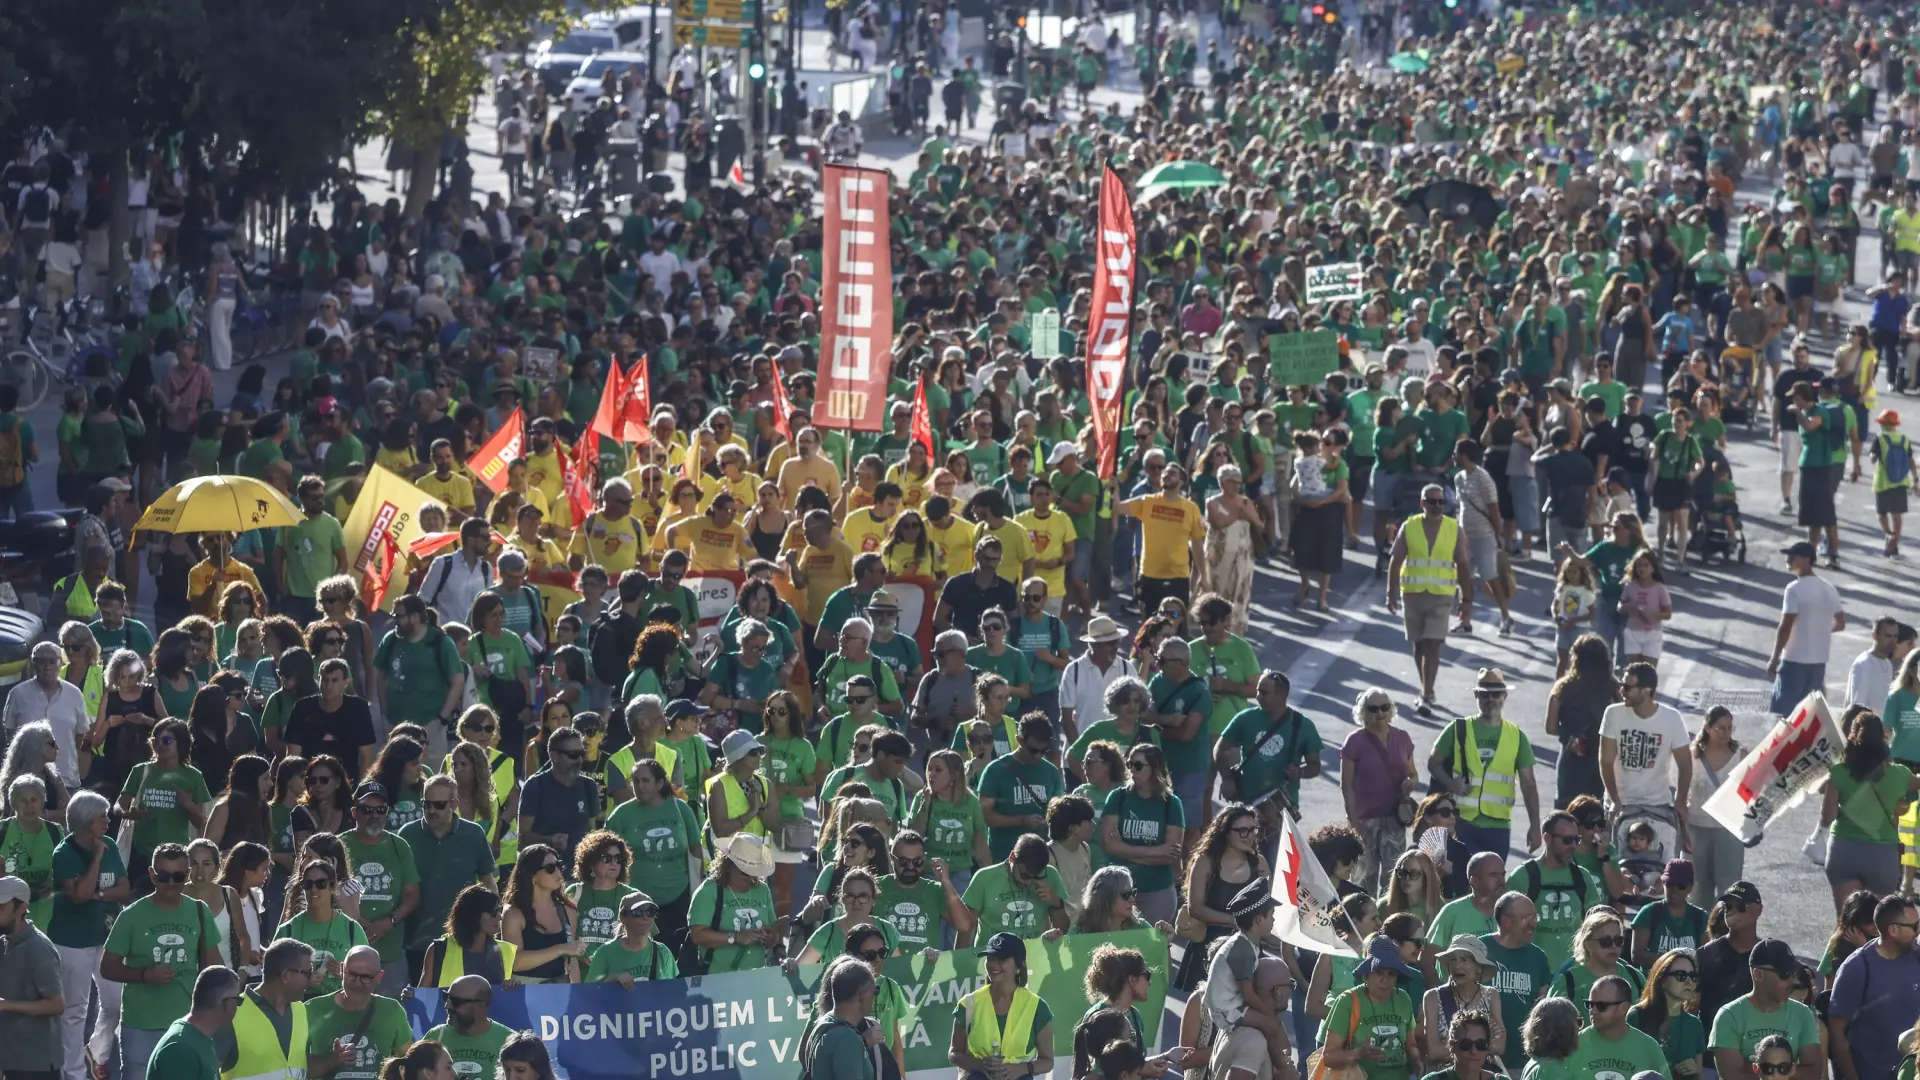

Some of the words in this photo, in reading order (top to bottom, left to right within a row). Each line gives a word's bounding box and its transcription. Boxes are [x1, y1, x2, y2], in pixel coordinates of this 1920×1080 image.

[831, 177, 875, 381] CCOO
[1122, 818, 1132, 835] LA
[540, 999, 755, 1042] DIGNIFIQUEM
[650, 1041, 758, 1079] PÚBLIC
[1587, 1058, 1637, 1074] ESTIMEM
